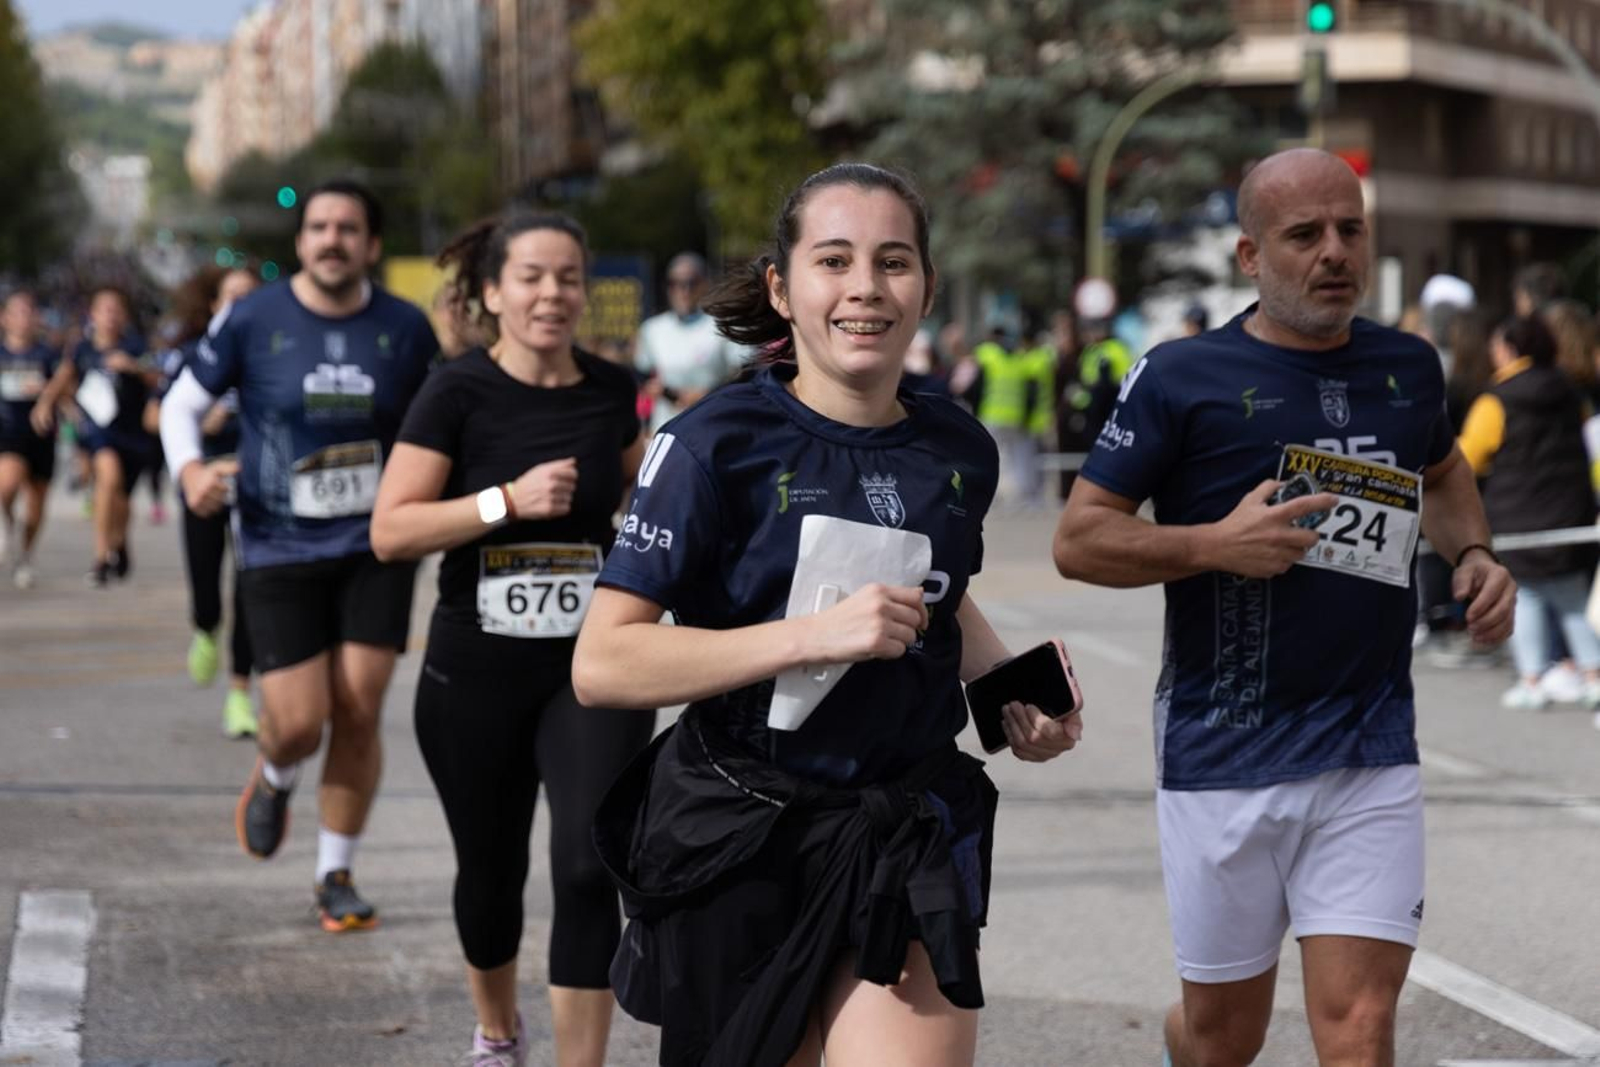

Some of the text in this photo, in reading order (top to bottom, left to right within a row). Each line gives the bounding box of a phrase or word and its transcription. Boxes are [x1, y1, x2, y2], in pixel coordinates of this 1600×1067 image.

[1287, 452, 1320, 474] XXV
[313, 471, 362, 501] 691
[1319, 503, 1387, 553] 24
[506, 581, 580, 615] 676
[1219, 643, 1238, 701] SANTA
[1240, 677, 1260, 703] DE
